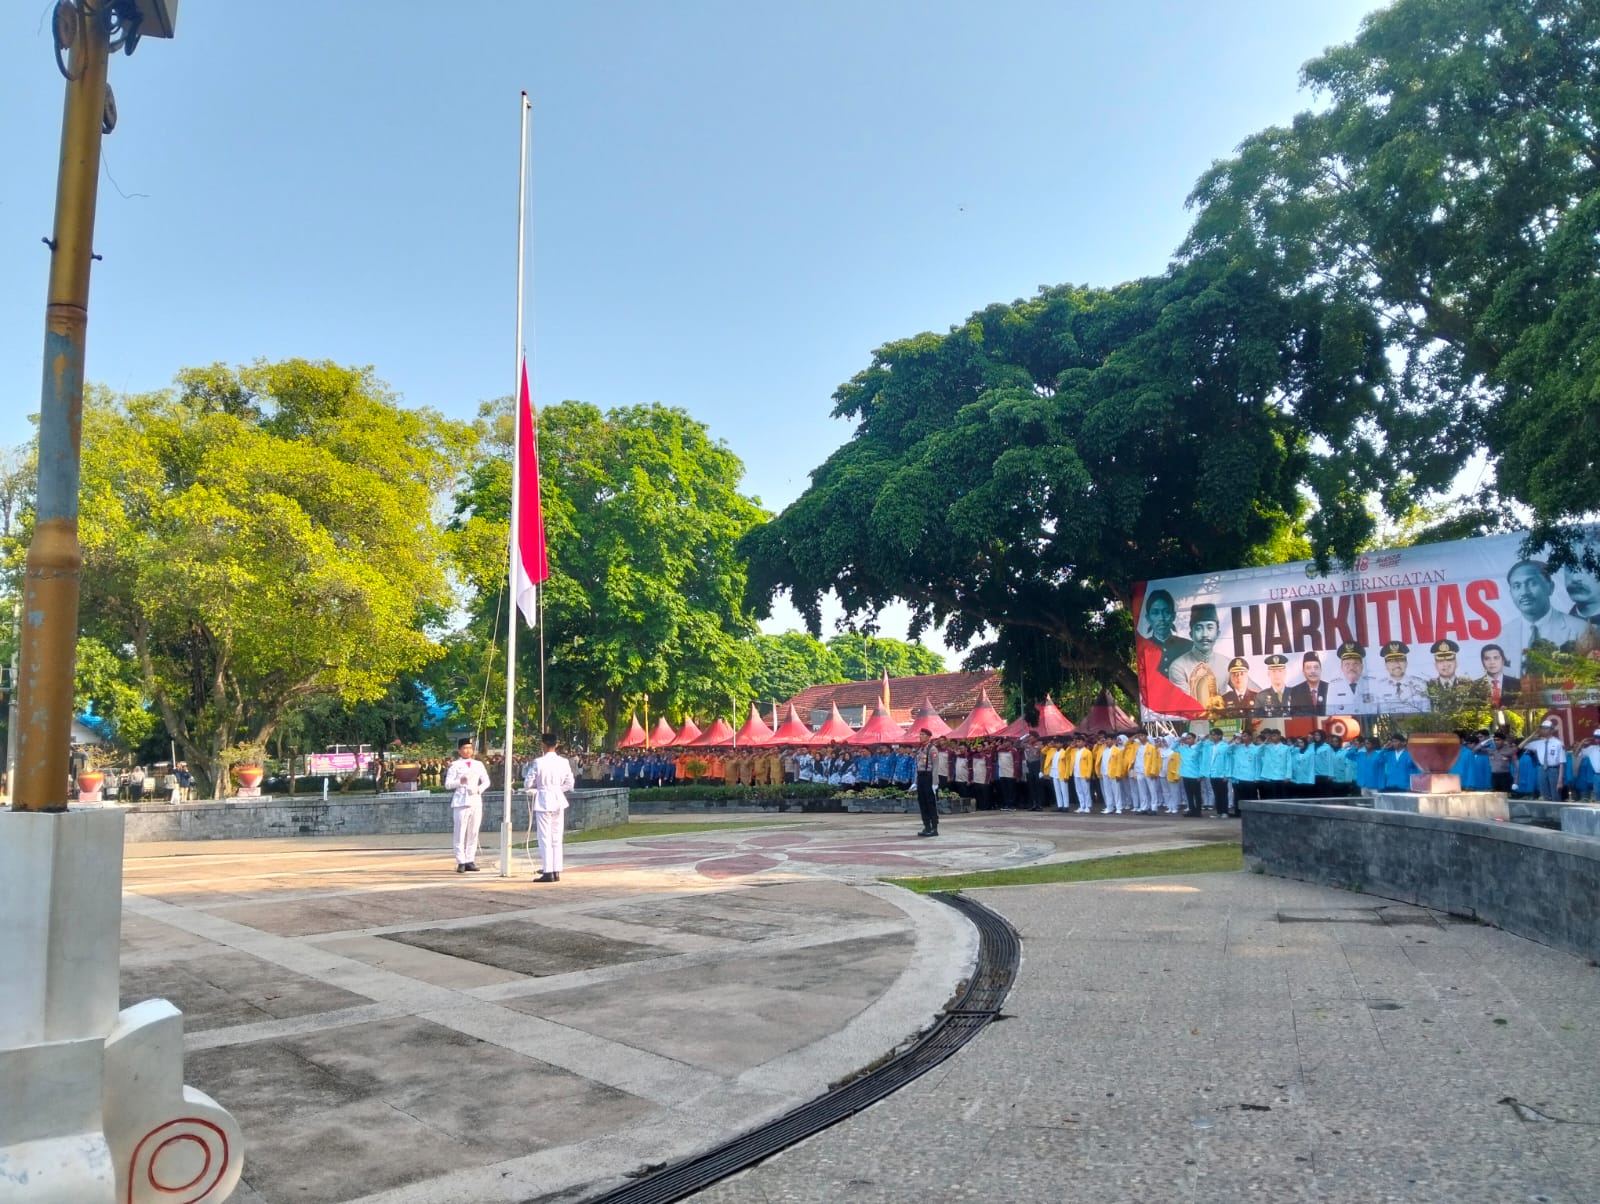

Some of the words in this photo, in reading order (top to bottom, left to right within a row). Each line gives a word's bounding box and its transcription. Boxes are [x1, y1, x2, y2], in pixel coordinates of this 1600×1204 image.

[1269, 582, 1337, 601] UPACARA
[1341, 569, 1446, 593] PERINGATAN
[1231, 579, 1502, 657] HARKITNAS
